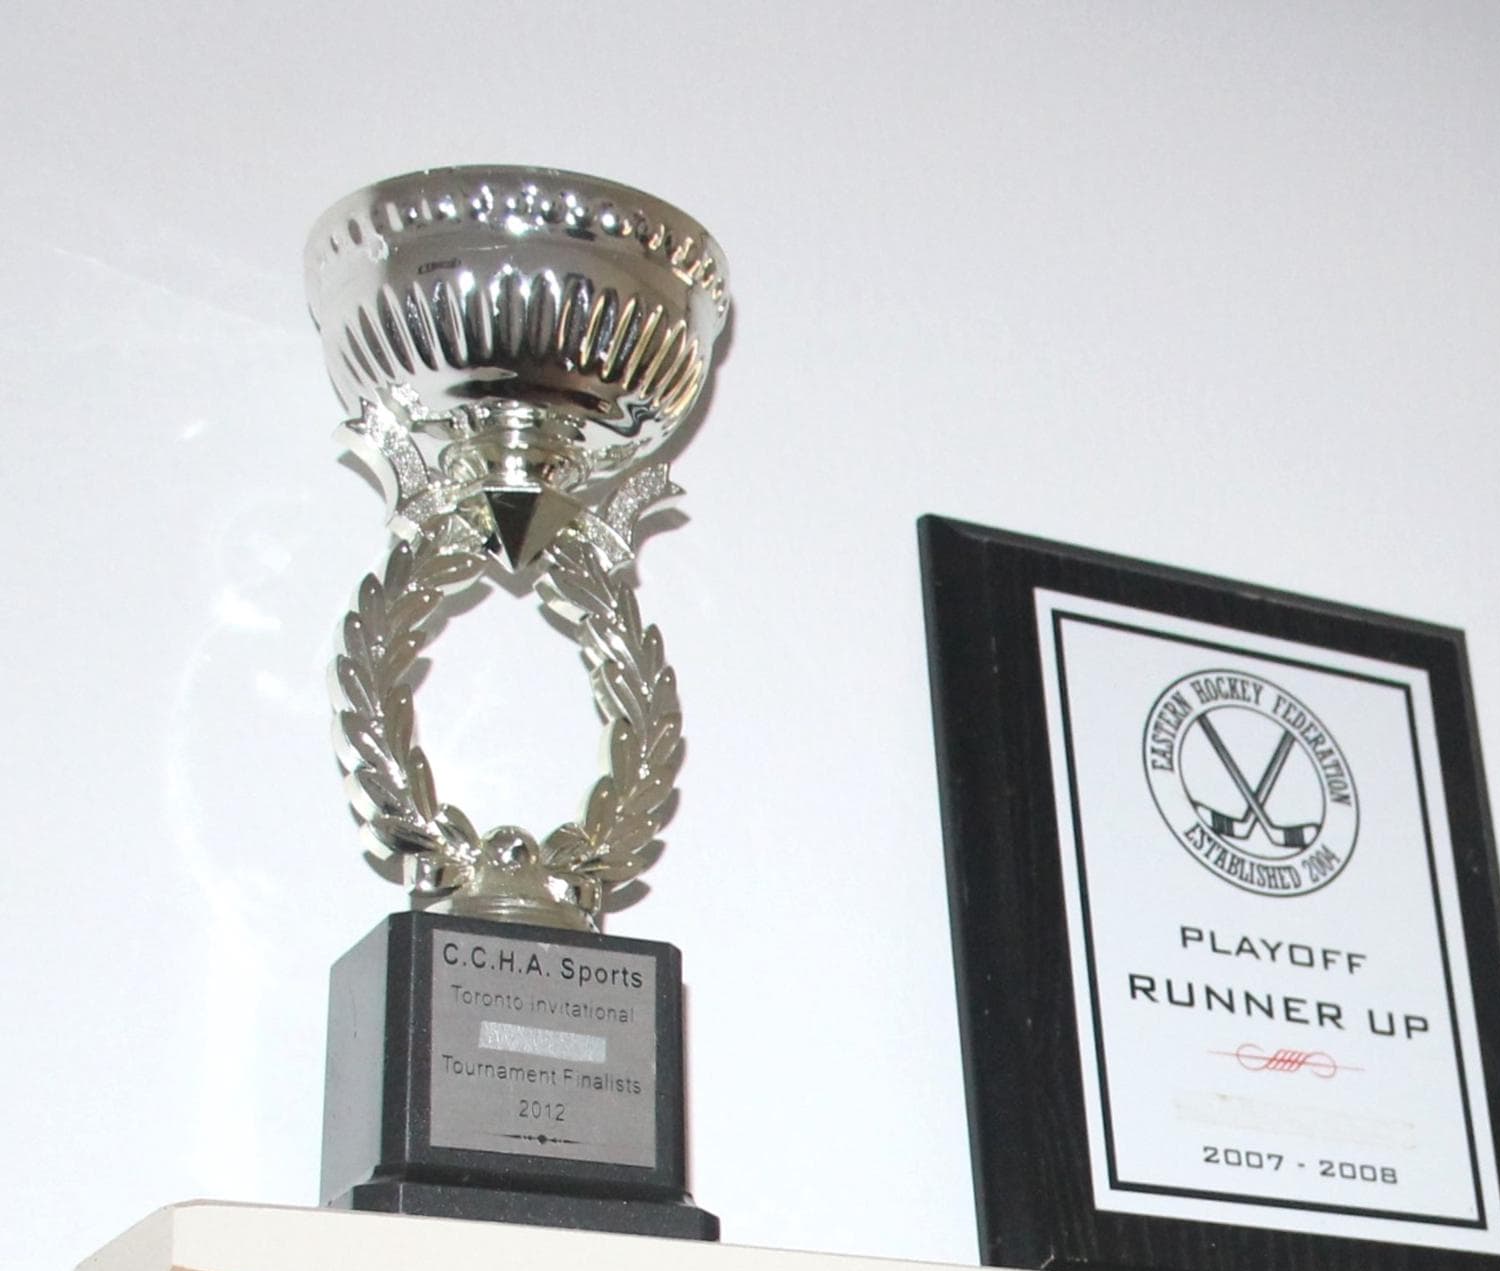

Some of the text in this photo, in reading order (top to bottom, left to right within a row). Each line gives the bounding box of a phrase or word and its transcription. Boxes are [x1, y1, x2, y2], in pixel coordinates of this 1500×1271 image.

[1151, 676, 1352, 806] EASTERN HOCKEY FEDERATION
[1183, 822, 1340, 890] ESTABLISHED 2004
[442, 943, 643, 988] C.C.H.A. Sports
[1180, 926, 1366, 975] PLAYOFF
[451, 984, 523, 1011] Toronto
[1128, 973, 1429, 1039] RUNNER UP
[441, 1054, 642, 1094] Tournament Finalists
[519, 1100, 566, 1122] 2012
[1203, 1146, 1283, 1171] 2007
[1319, 1160, 1398, 1184] 2008
